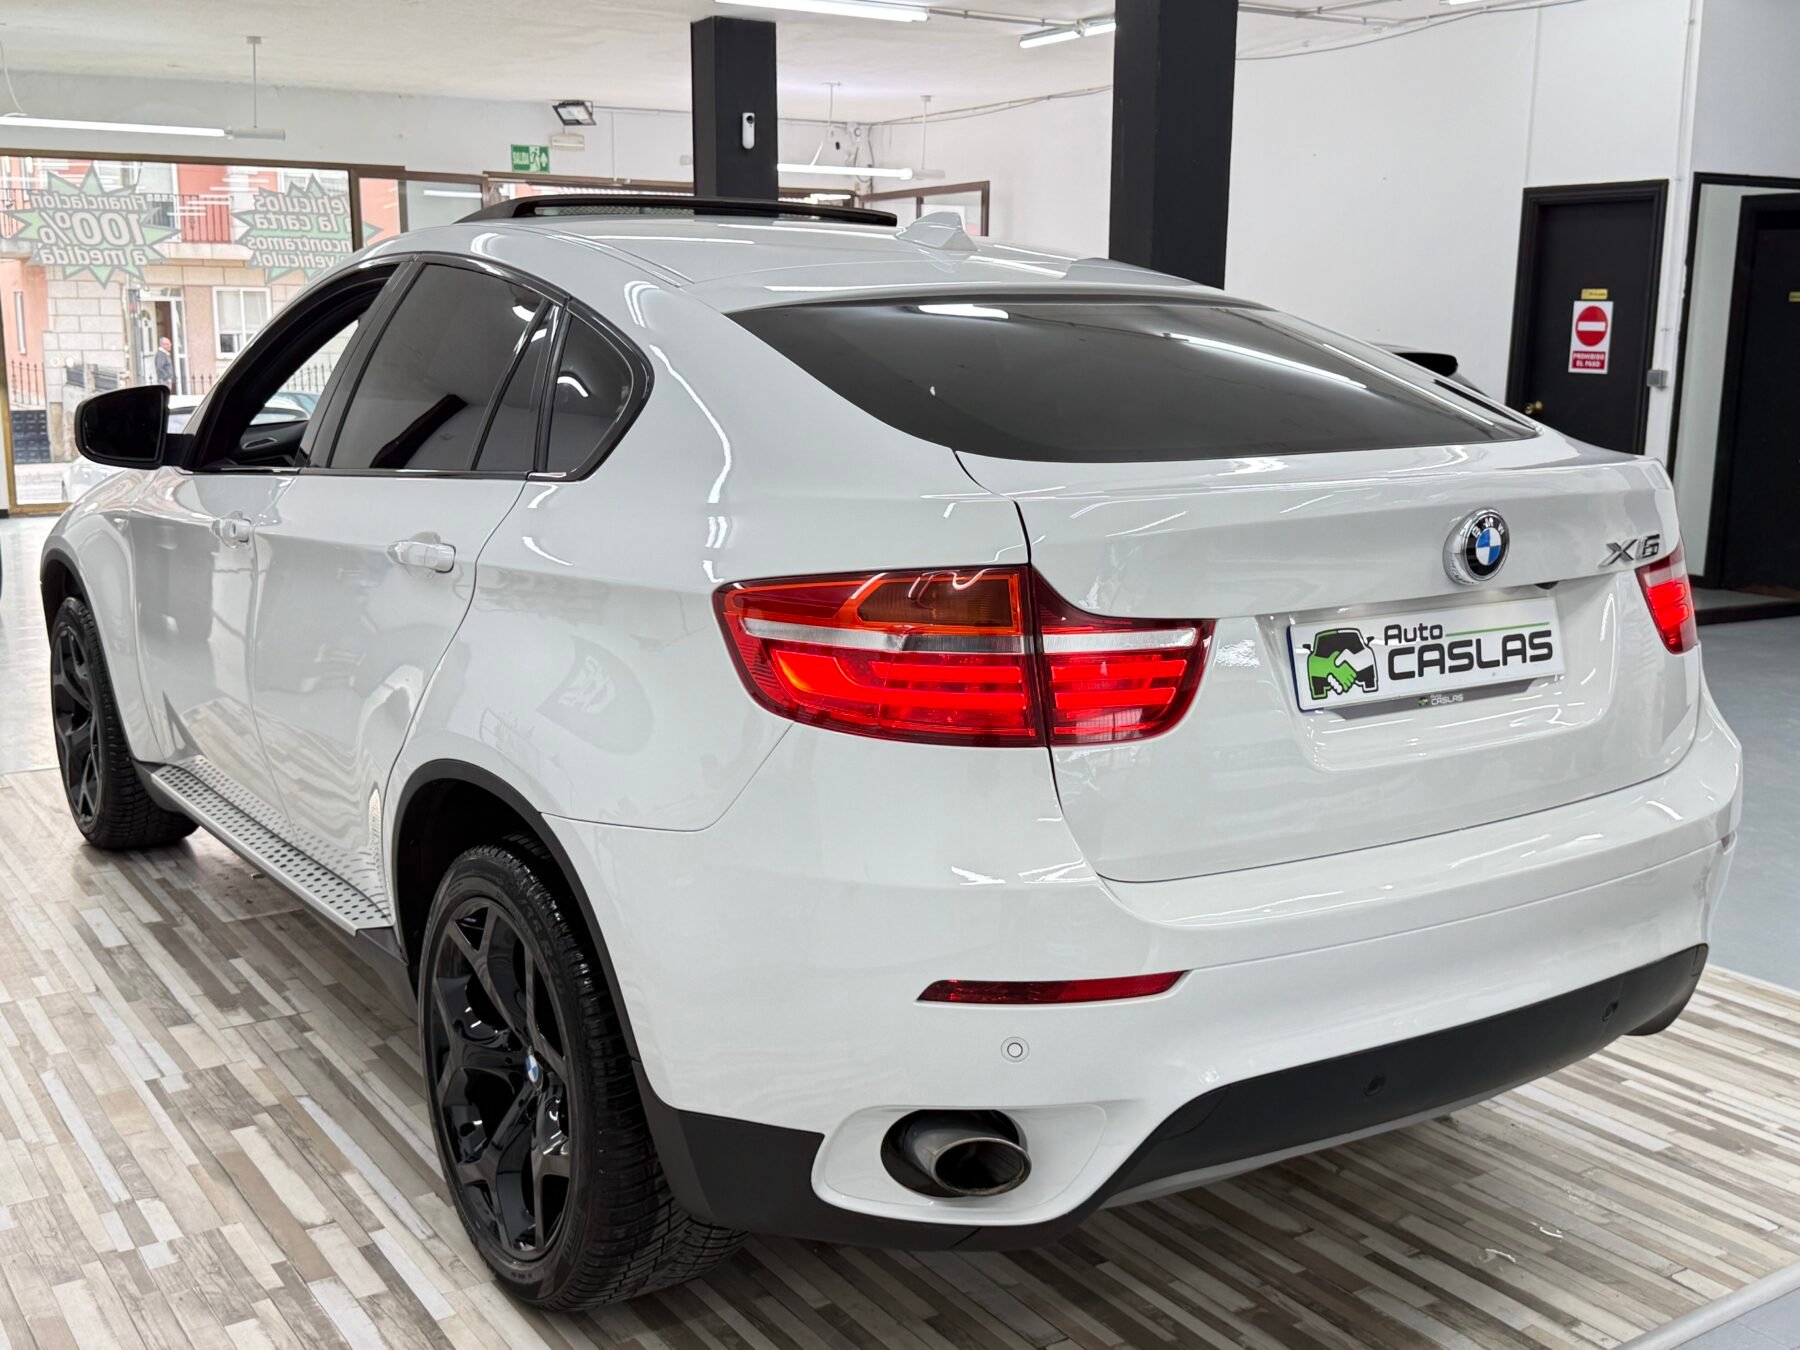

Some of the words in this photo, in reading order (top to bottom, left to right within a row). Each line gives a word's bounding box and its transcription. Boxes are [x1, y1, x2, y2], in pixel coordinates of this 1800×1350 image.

[1472, 517, 1504, 538] BMW
[1599, 534, 1660, 567] X6
[1384, 623, 1443, 646] Auto
[1388, 630, 1553, 681] CASLAS
[1431, 693, 1464, 706] CASLAS
